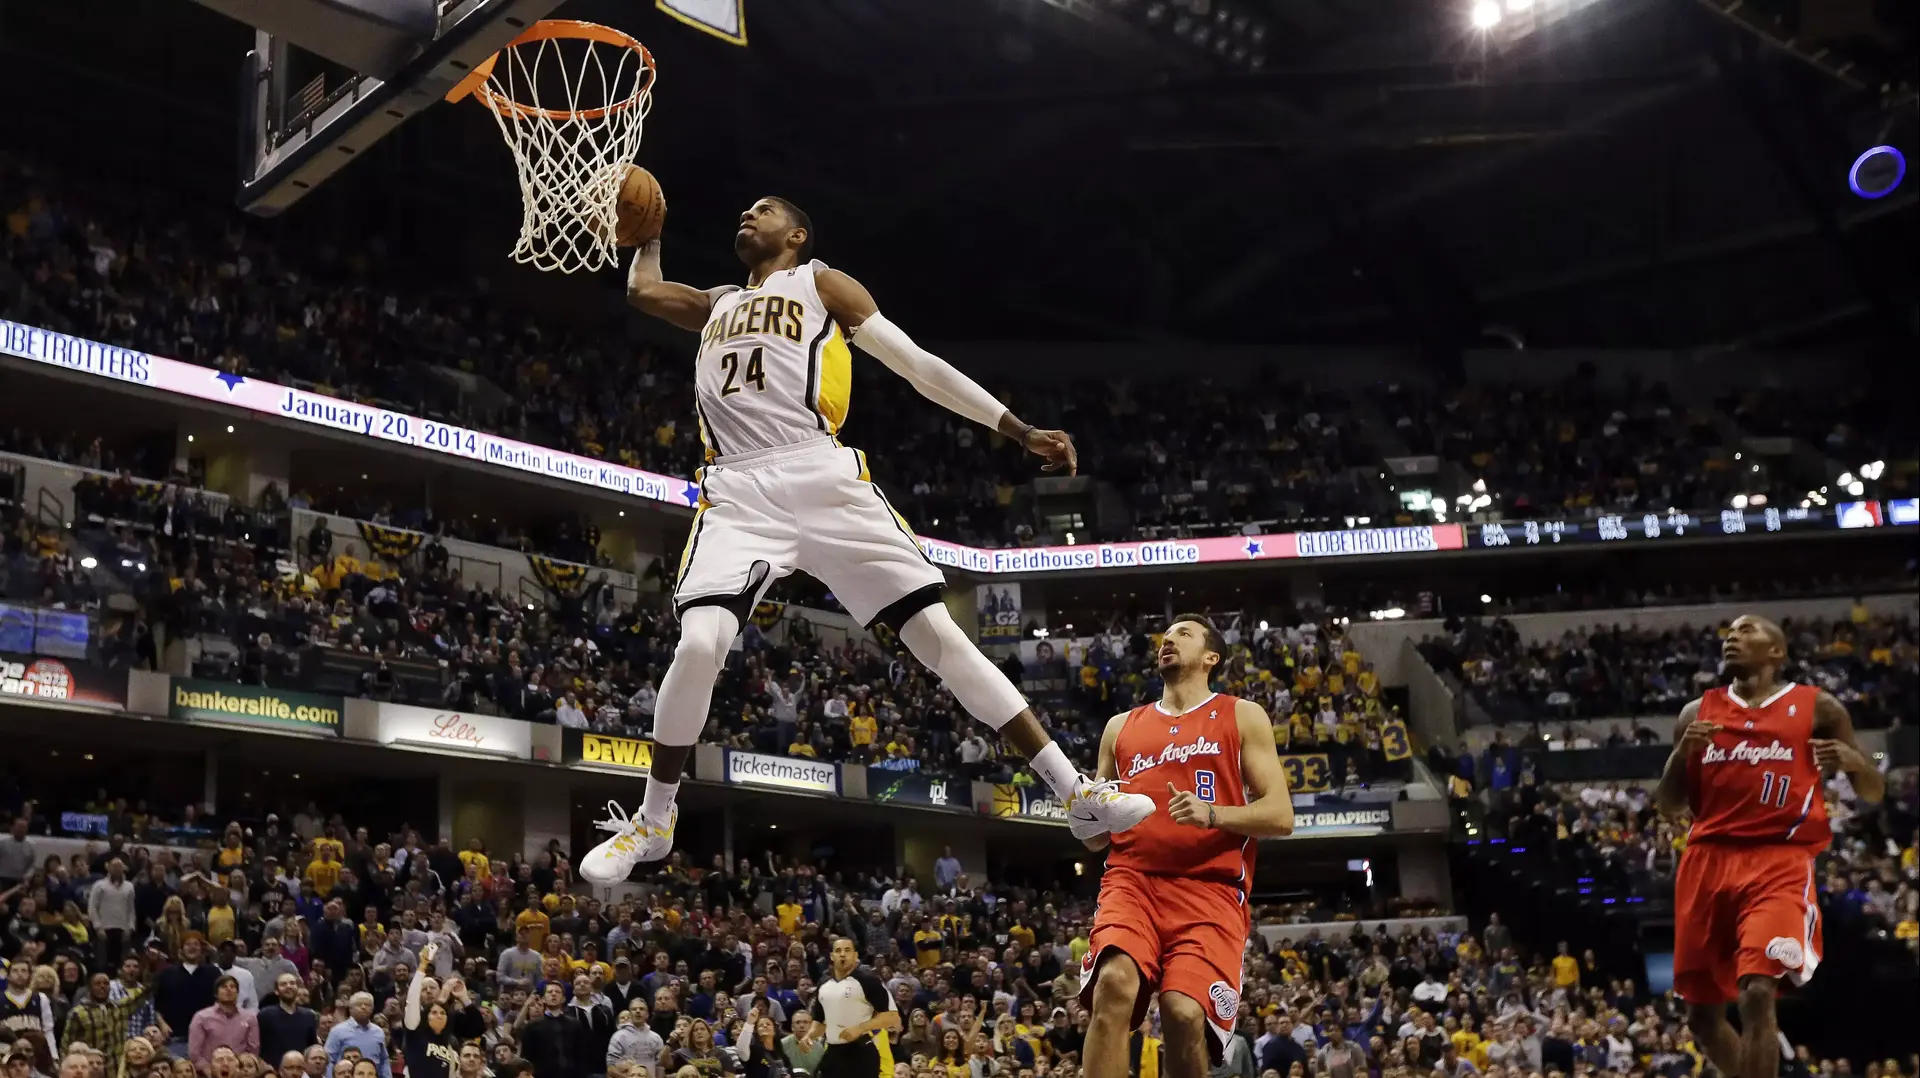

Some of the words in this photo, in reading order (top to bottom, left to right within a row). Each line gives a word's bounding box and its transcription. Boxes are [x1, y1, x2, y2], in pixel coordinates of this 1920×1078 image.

[702, 296, 804, 350] PACERS
[719, 346, 767, 398] 24
[282, 391, 373, 435] January
[382, 414, 415, 445] 20,
[424, 424, 476, 453] 2014
[484, 441, 541, 468] (Martin
[547, 456, 593, 480] Luther
[600, 468, 630, 494] King
[636, 476, 666, 501] Day)
[961, 549, 988, 569] Life
[995, 551, 1094, 570] Fieldhouse
[1102, 548, 1134, 564] Box
[1142, 545, 1196, 562] Office
[1299, 528, 1432, 554] GLOBETROTTERS
[996, 611, 1019, 625] G2
[176, 685, 338, 724] bankerslife.com
[429, 714, 484, 748] Lilly
[1384, 725, 1407, 756] 3
[583, 736, 653, 767] DEWA
[1128, 753, 1156, 777] Los
[1157, 736, 1221, 763] Angeles
[1702, 742, 1726, 764] Los
[1728, 740, 1793, 765] Angeles
[732, 755, 833, 784] ticketmaster
[1195, 769, 1216, 803] 8
[1283, 757, 1329, 790] 33
[1759, 771, 1791, 808] 11
[1315, 810, 1390, 826] GRAPHICS
